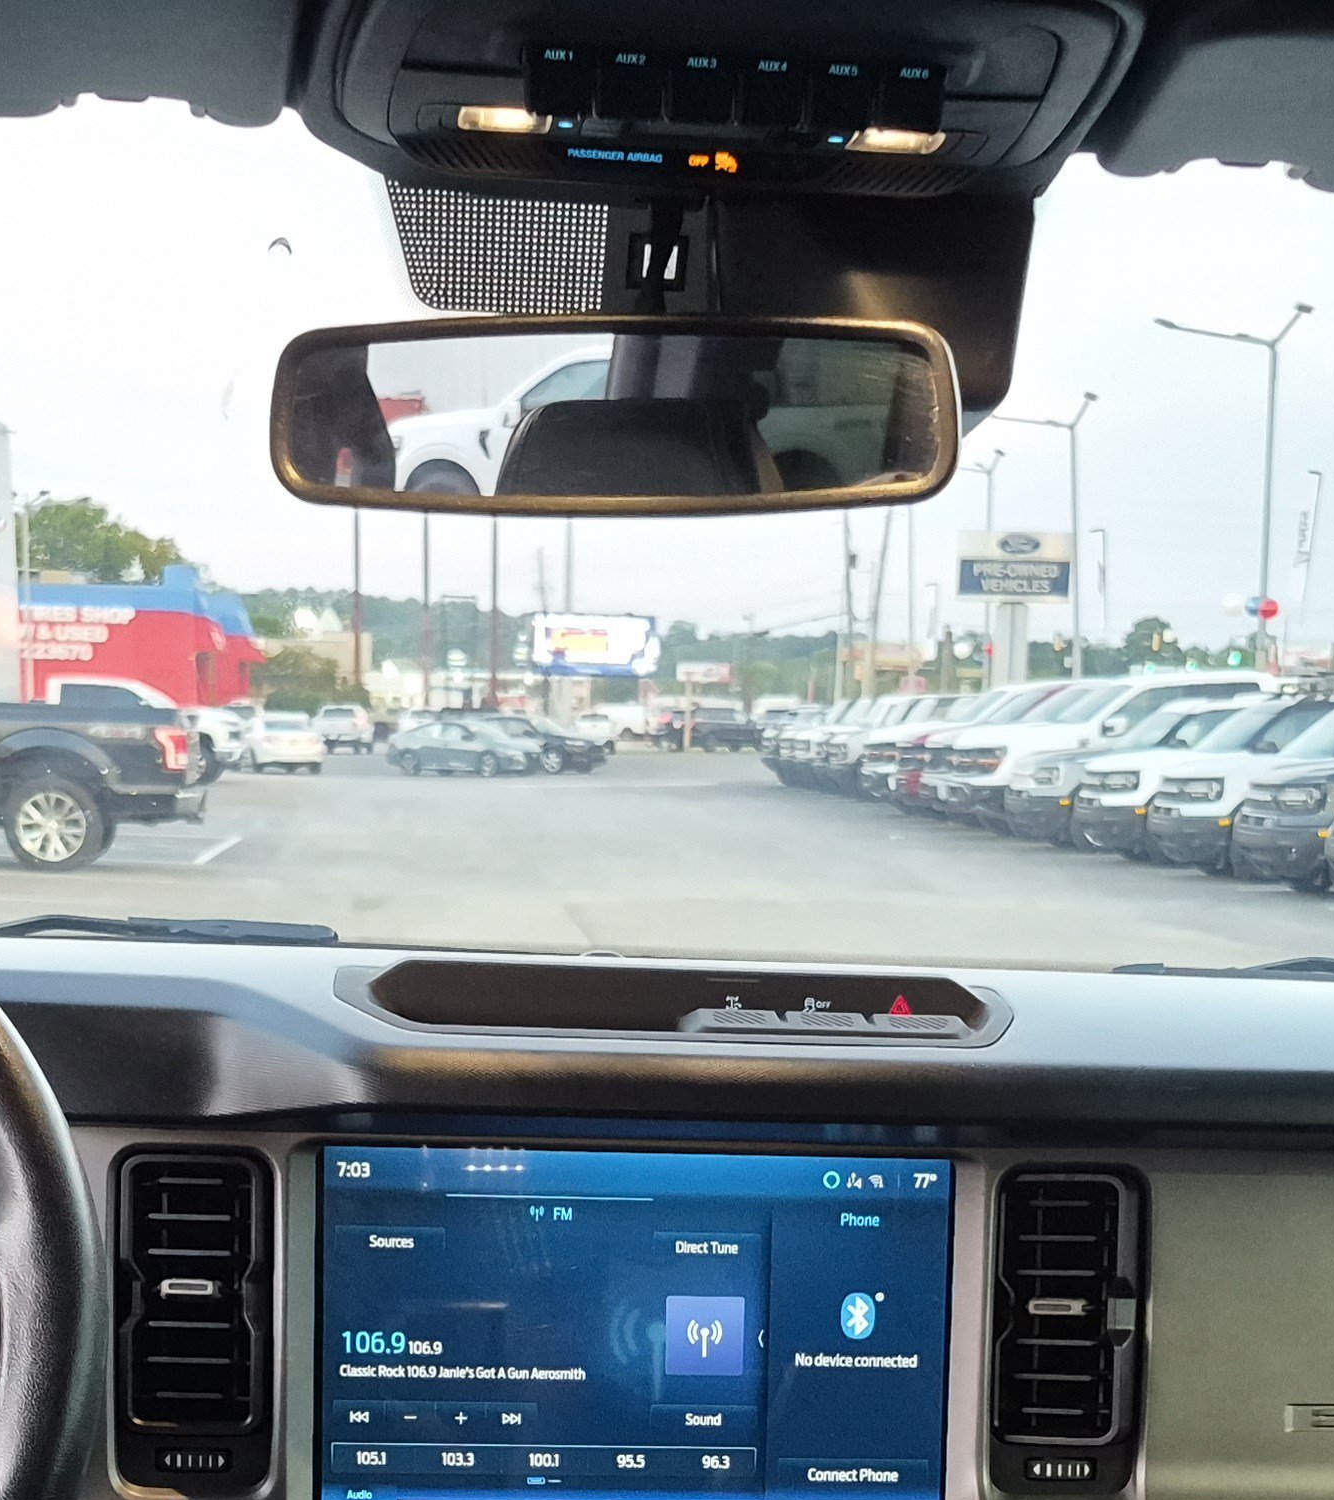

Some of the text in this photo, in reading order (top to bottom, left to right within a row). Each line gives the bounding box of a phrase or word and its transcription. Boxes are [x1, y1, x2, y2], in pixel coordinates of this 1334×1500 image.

[567, 148, 625, 161] PASSENGER
[627, 152, 663, 164] AIRBAG
[973, 562, 1061, 578] PRE-OWNED
[981, 578, 1053, 593] VEHICLES
[80, 605, 136, 625] SHOP
[337, 1162, 371, 1178] 7:03
[553, 1207, 573, 1221] FM
[840, 1213, 880, 1227] Phone
[369, 1235, 415, 1249] Sources
[675, 1241, 739, 1255] Direct Tune
[342, 1331, 443, 1355] 106.9 106.9
[795, 1353, 918, 1368] No device connected
[339, 1364, 586, 1382] Classic Rock 106.9 Janie's Got A Gun Aerosmith
[685, 1413, 722, 1427] Sound
[356, 1451, 387, 1466] 105.1
[441, 1452, 475, 1467] 103.3
[528, 1453, 560, 1468] 100.1
[617, 1454, 646, 1469] 95.5
[701, 1455, 731, 1470] 96.3
[807, 1468, 899, 1483] Connect Phone
[347, 1489, 373, 1500] Audio
